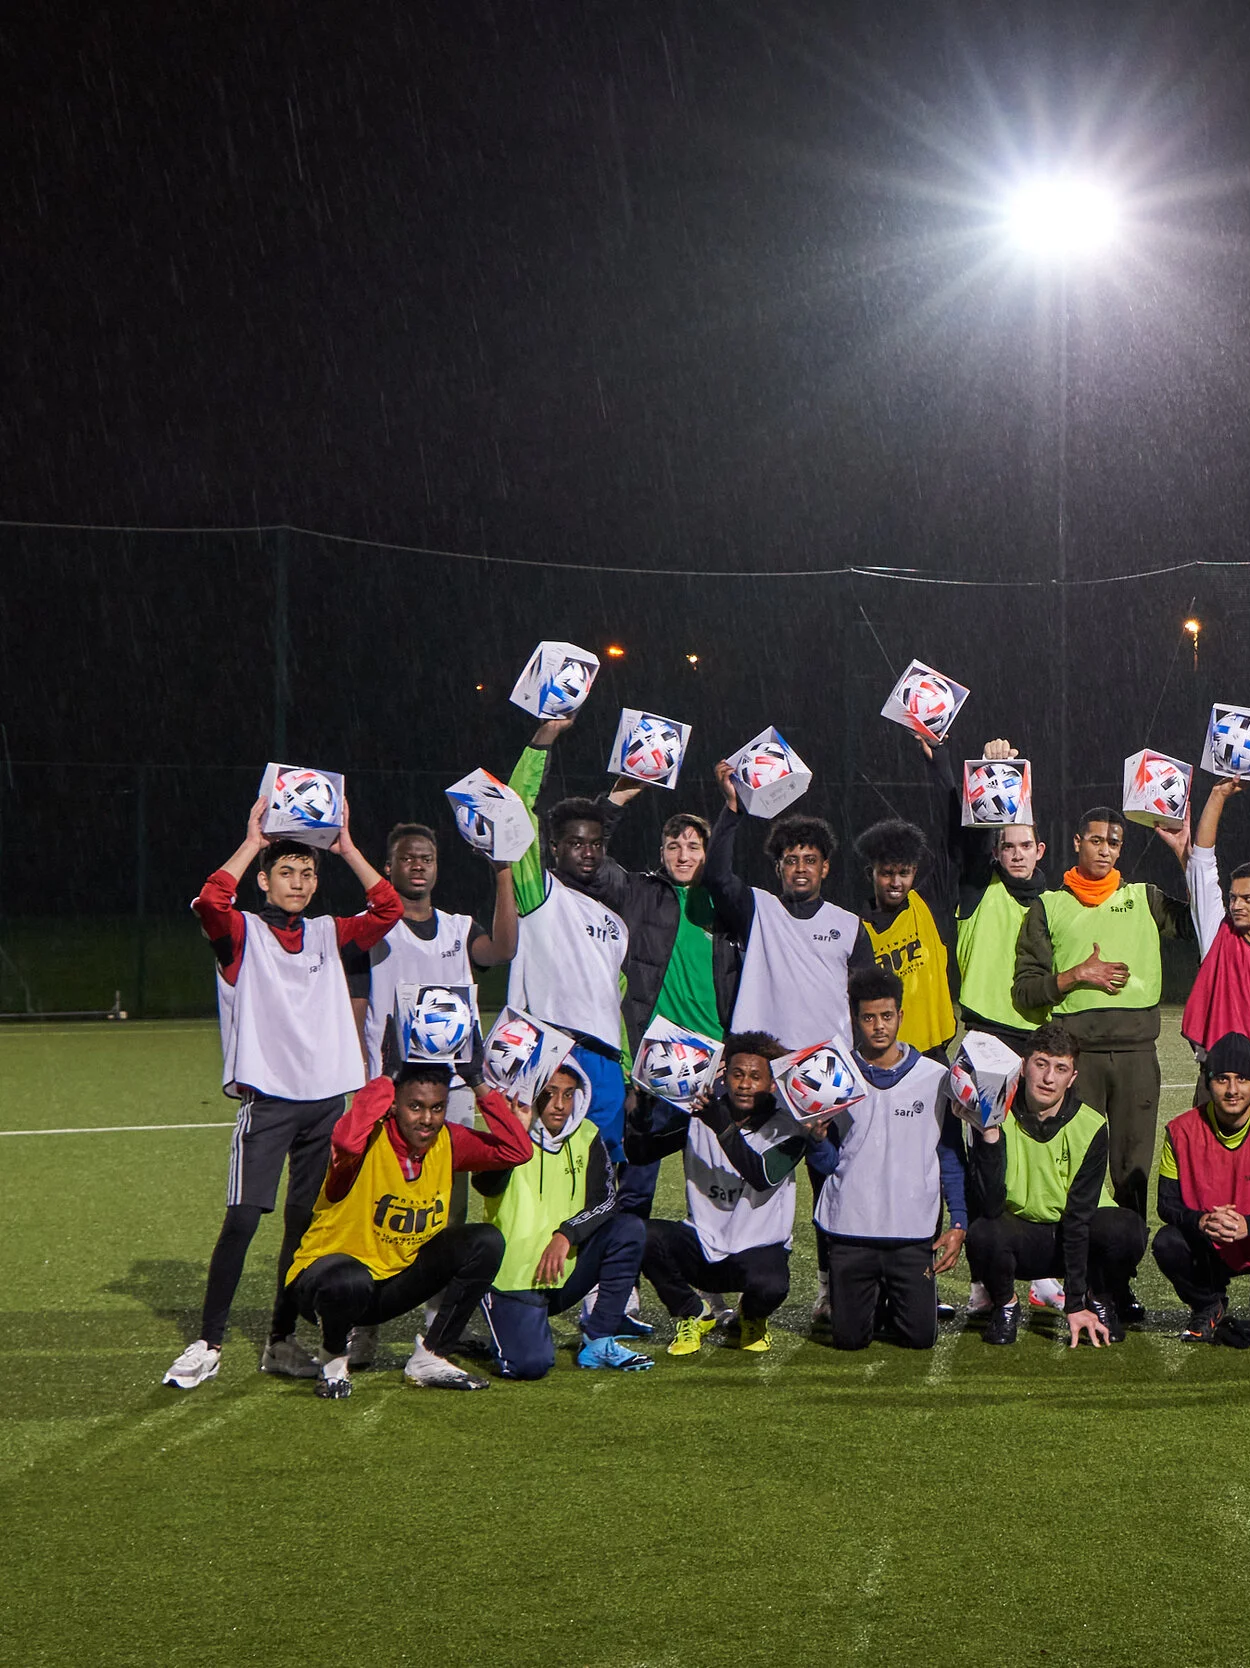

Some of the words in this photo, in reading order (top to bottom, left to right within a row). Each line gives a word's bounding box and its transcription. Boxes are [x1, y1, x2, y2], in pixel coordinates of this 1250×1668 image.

[586, 925, 607, 942] ari
[813, 934, 831, 942] sari
[874, 938, 923, 972] are
[895, 1109, 914, 1118] sari
[374, 1193, 445, 1235] fare
